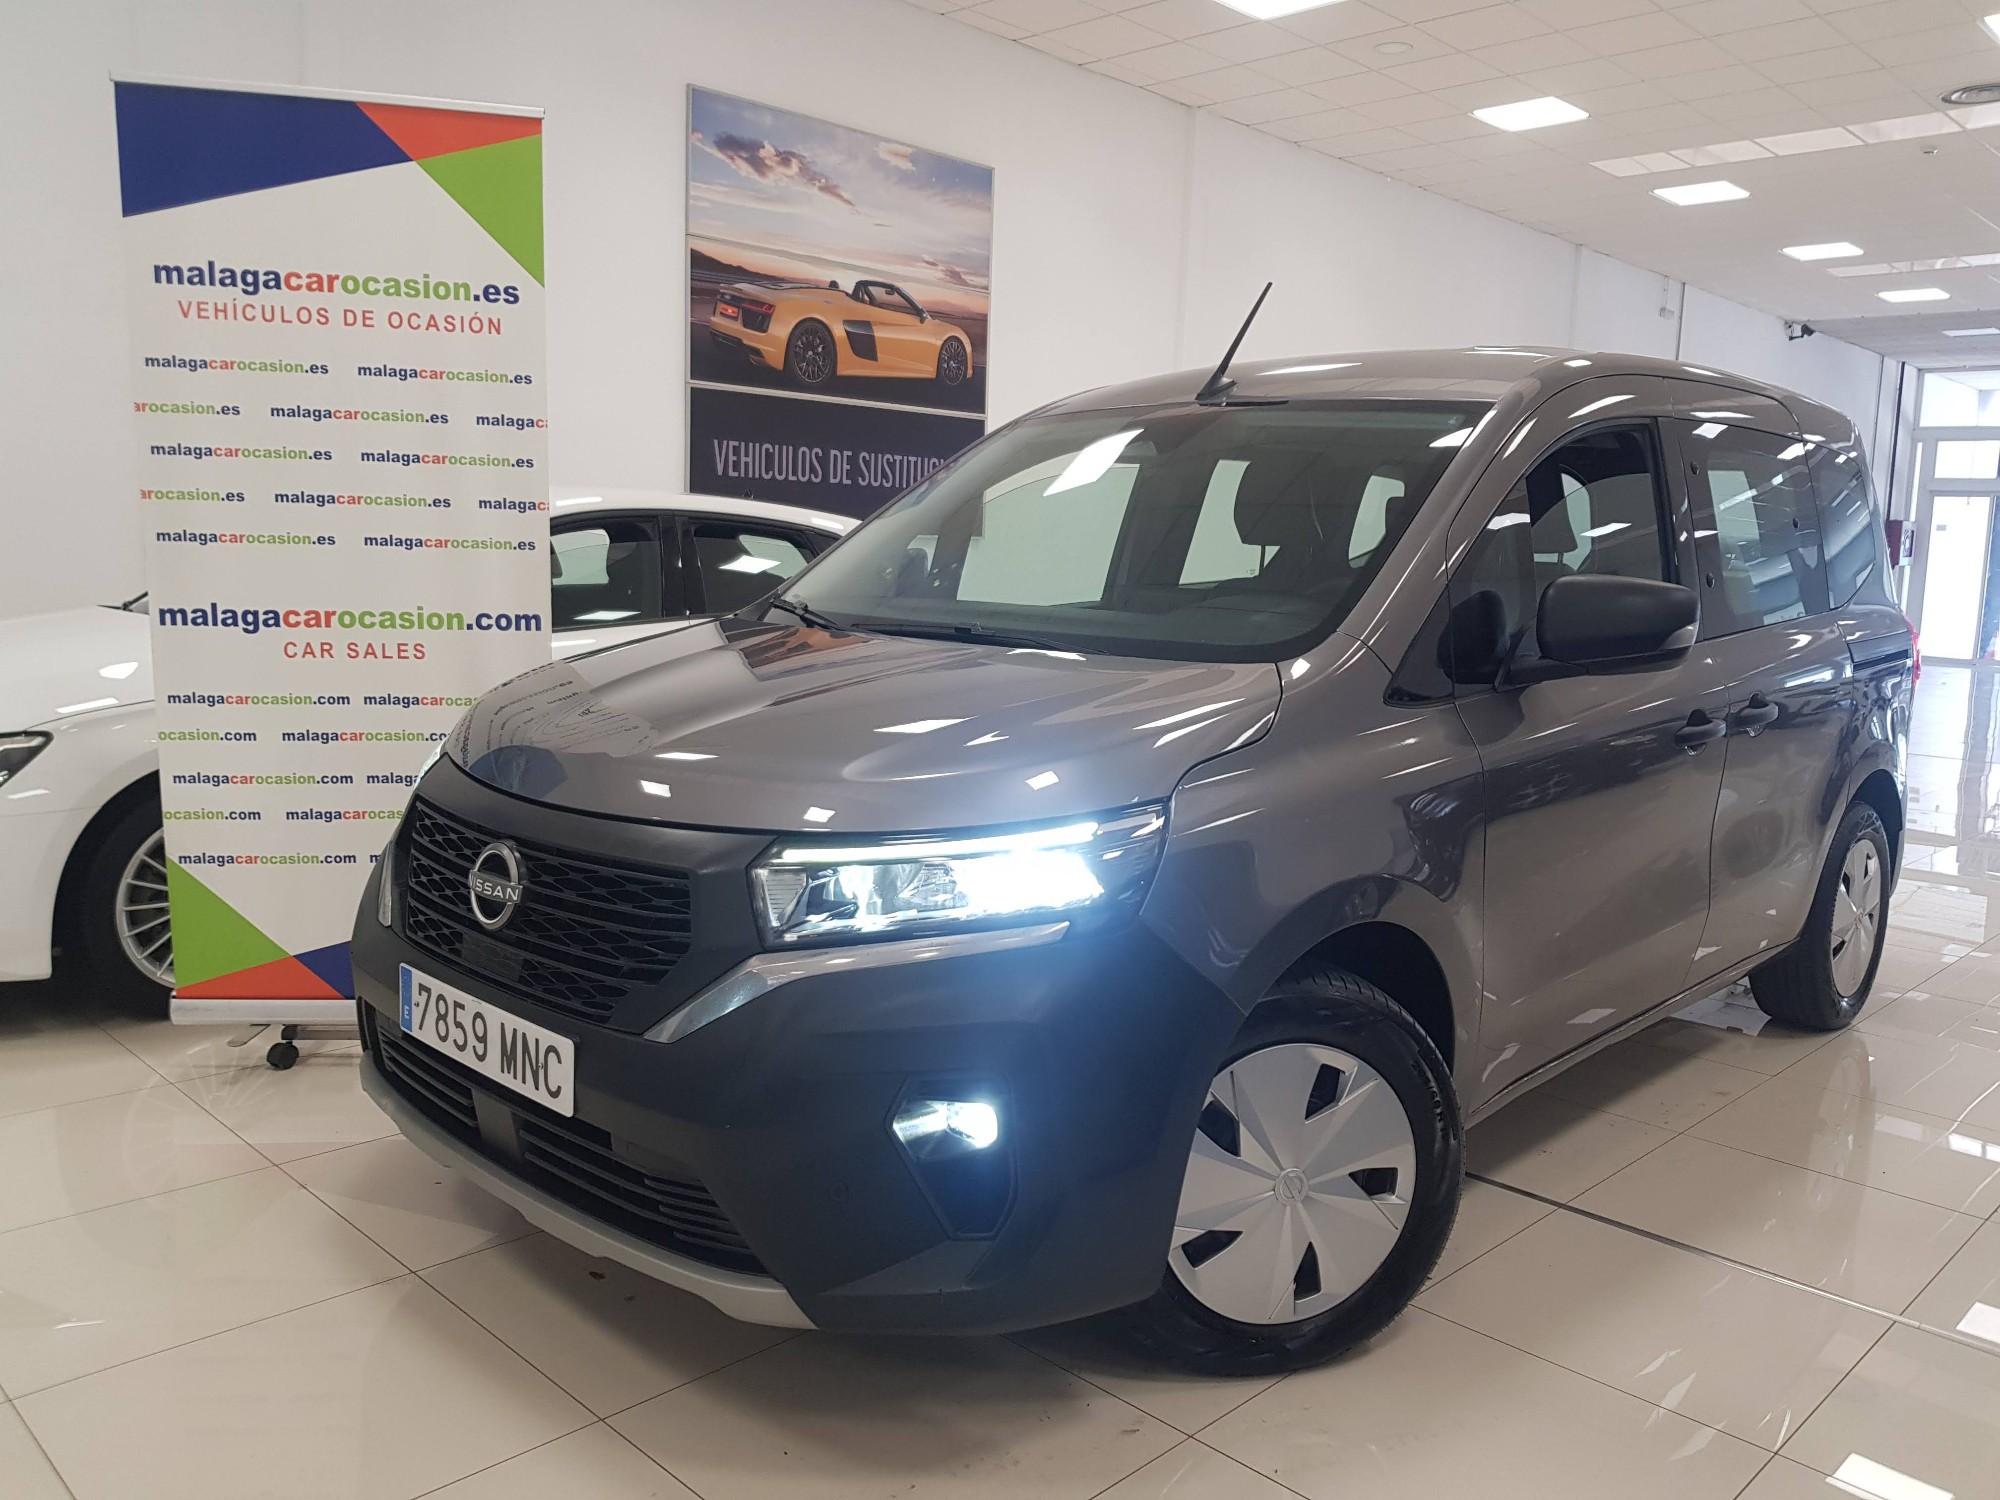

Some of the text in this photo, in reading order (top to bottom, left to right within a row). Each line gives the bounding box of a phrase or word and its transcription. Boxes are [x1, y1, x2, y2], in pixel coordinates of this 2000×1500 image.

[154, 260, 520, 305] malagacarocasion.es
[178, 298, 500, 335] VEHÍCULOS DE OCASIÓN
[145, 355, 532, 384] malagacarocasion.es malagacarocasion.es
[271, 405, 448, 424] malagacarocasion.es
[477, 414, 547, 430] malagac
[151, 443, 534, 468] malagacarocasion.es malagacarocasion.es
[713, 439, 823, 482] VEHICULOS
[829, 449, 853, 485] DE
[275, 491, 451, 508] malagacarocasion.es
[479, 498, 548, 513] malagac
[157, 529, 536, 550] malagacarocasion.es malagacarocasion.es
[159, 602, 541, 634] malagacarocasion.com
[284, 642, 425, 659] CAR SALES
[168, 692, 477, 709] malagacarocasion.com malagacaroca
[159, 729, 450, 745] ocasion.com malagacarocasion.co
[173, 772, 353, 787] malagacarocasion.com
[163, 808, 261, 820] ocasion.com
[178, 853, 356, 867] malagacarocasion.com
[470, 872, 519, 901] NISSAN
[404, 1005, 410, 1019] E
[418, 982, 562, 1099] 7859 MNC
